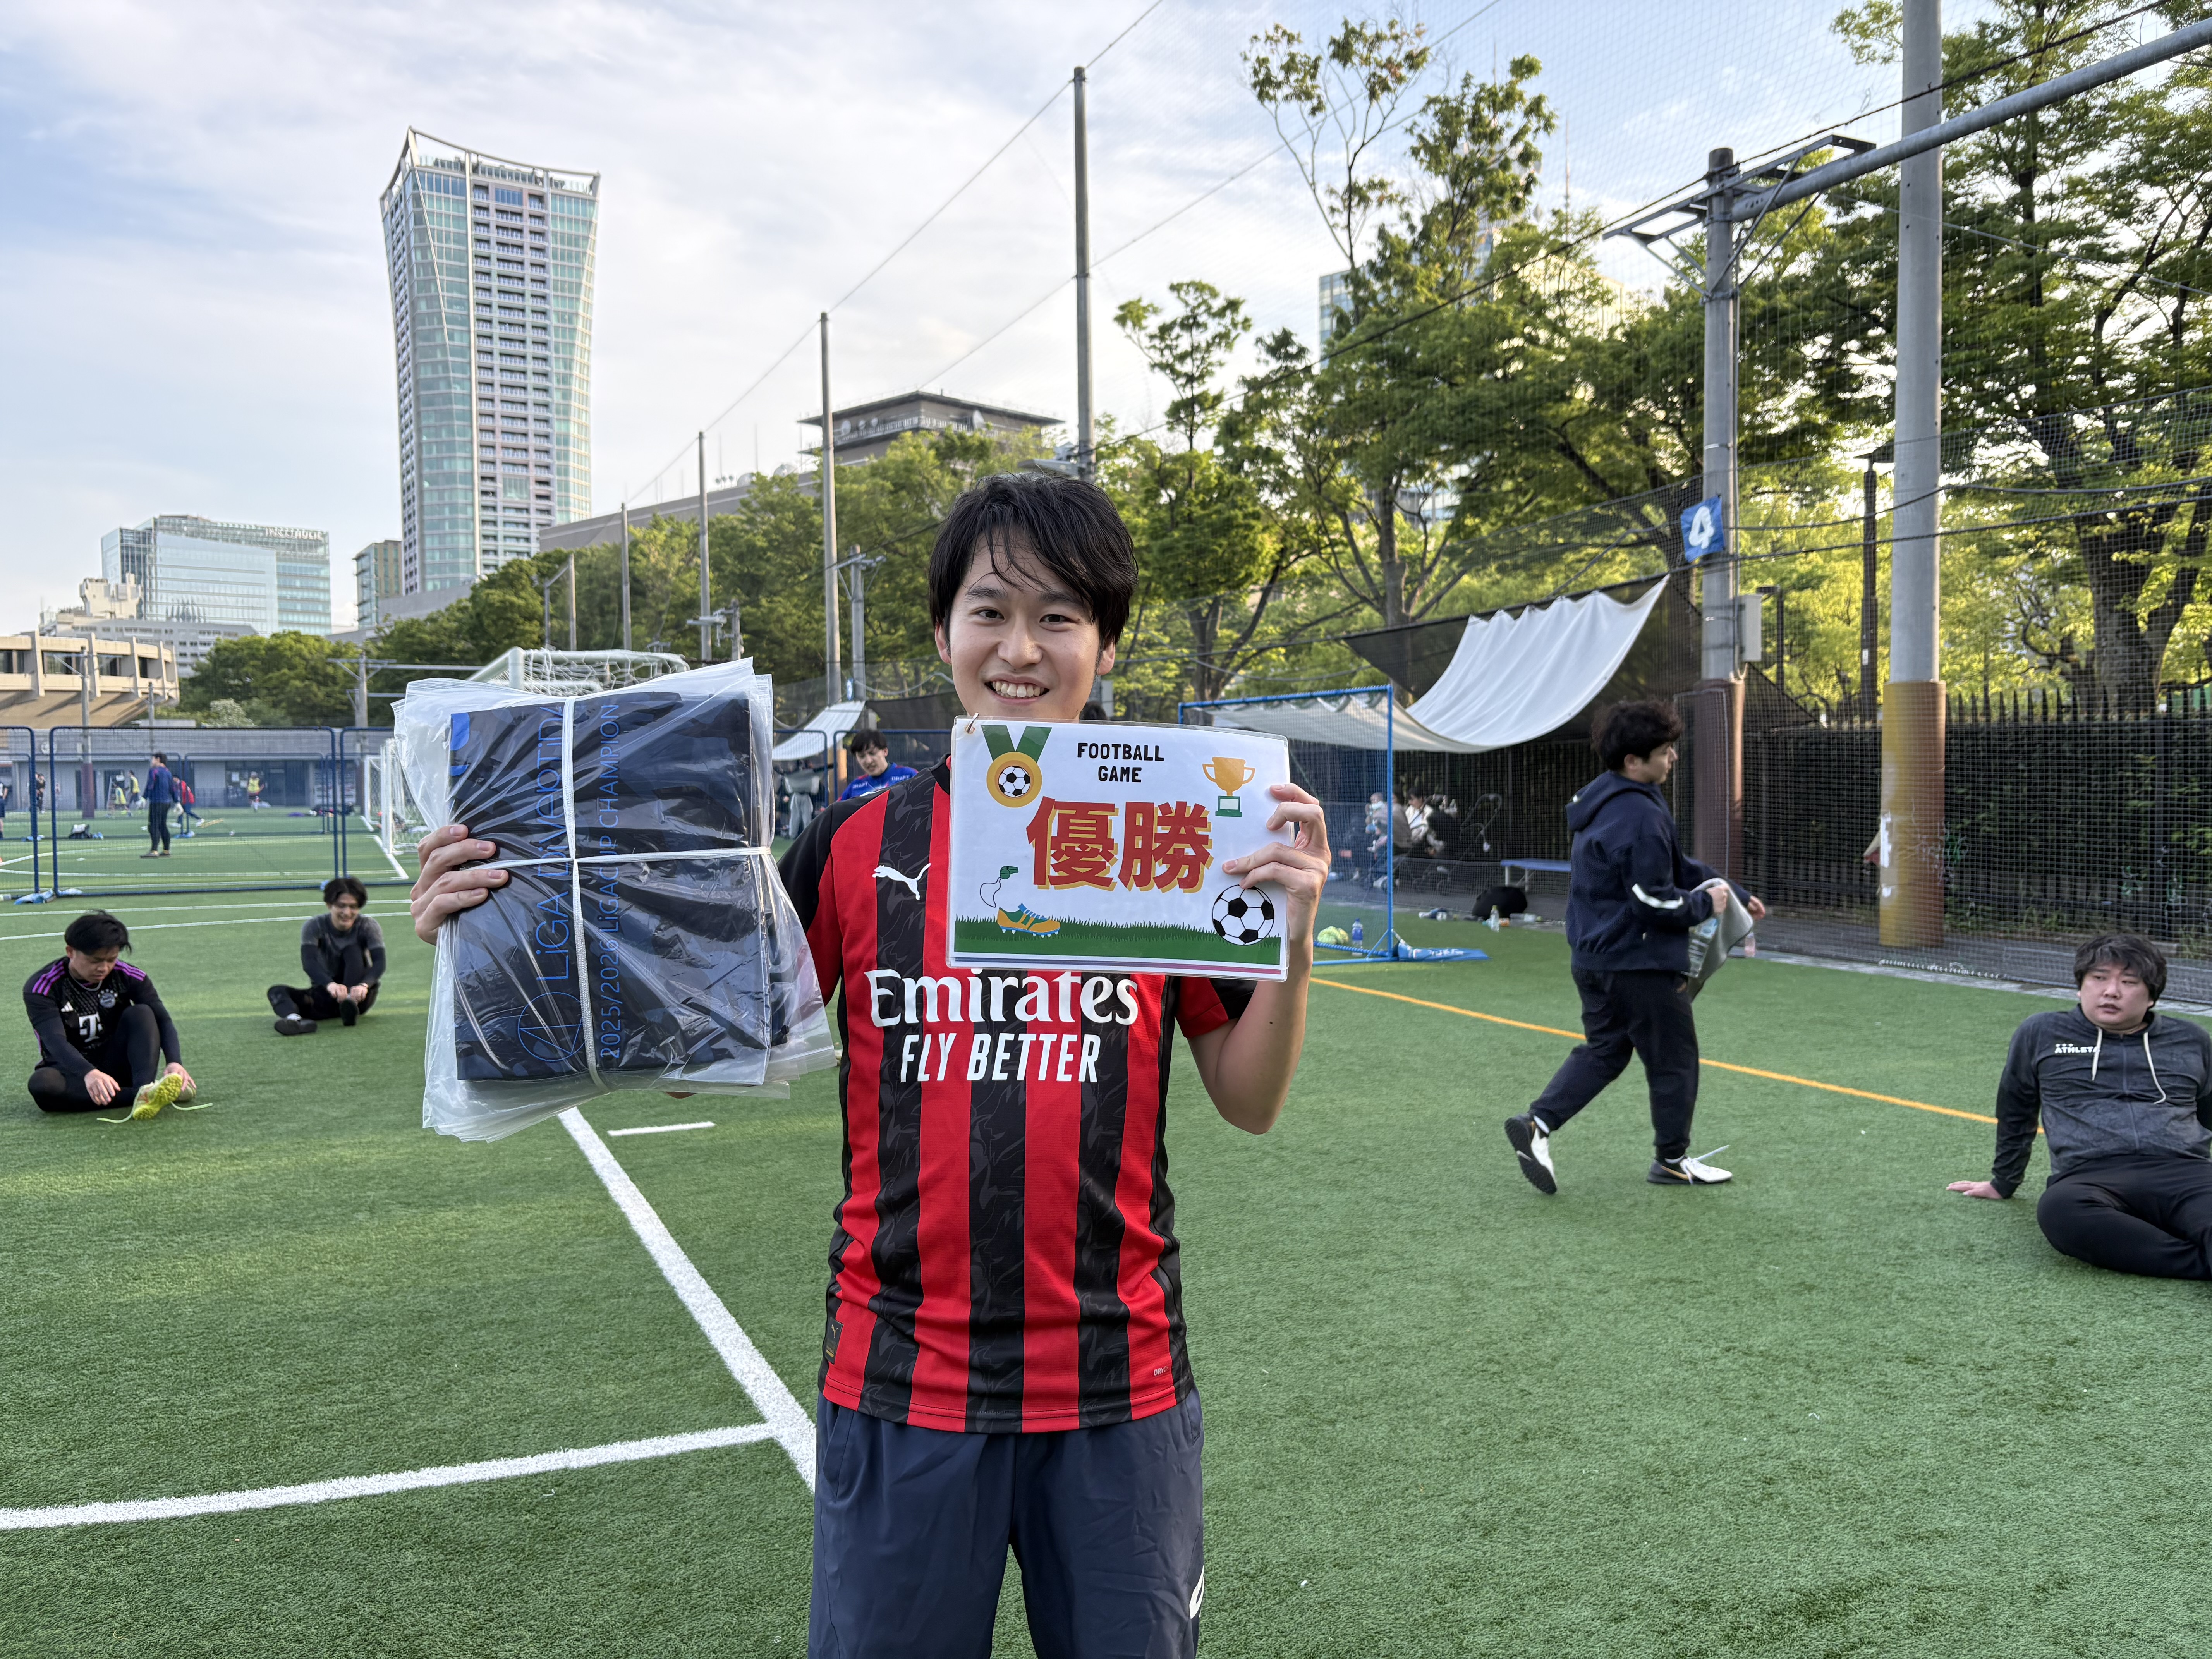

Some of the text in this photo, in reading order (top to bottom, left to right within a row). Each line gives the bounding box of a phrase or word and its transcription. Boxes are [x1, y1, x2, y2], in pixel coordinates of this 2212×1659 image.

[1688, 505, 1714, 549] 4
[599, 704, 620, 828] CHAMPION
[1077, 742, 1164, 762] FOOTBALL
[1098, 765, 1142, 783] GAME
[1026, 796, 1216, 893] 優勝
[600, 940, 623, 1059] 2025/2026
[864, 968, 1138, 1027] Emirates
[900, 1032, 1101, 1083] FLY BETTER
